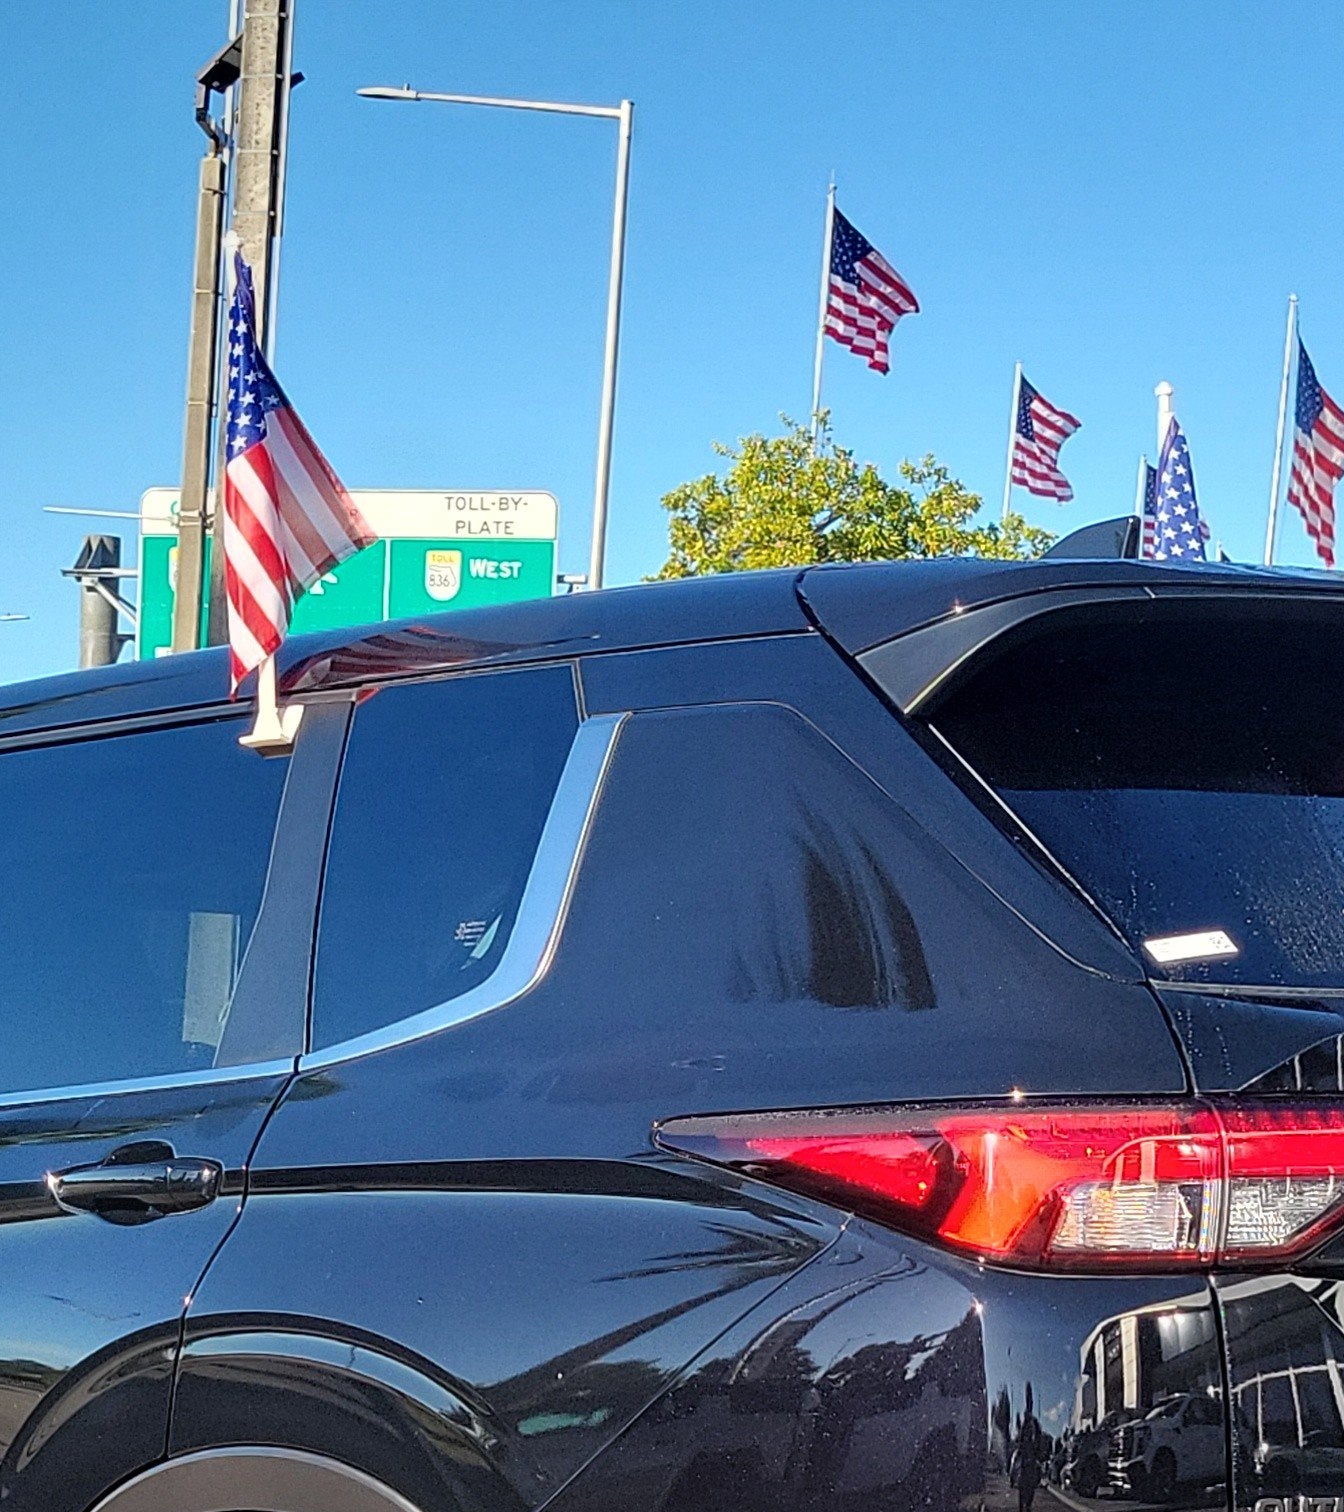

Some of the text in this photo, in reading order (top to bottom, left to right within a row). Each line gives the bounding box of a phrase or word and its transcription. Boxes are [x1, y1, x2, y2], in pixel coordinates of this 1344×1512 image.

[444, 496, 528, 511] TOLL-BY-
[455, 520, 514, 535] PLATE
[431, 553, 455, 563] TOLL
[469, 558, 523, 579] WEST
[429, 574, 450, 587] 836
